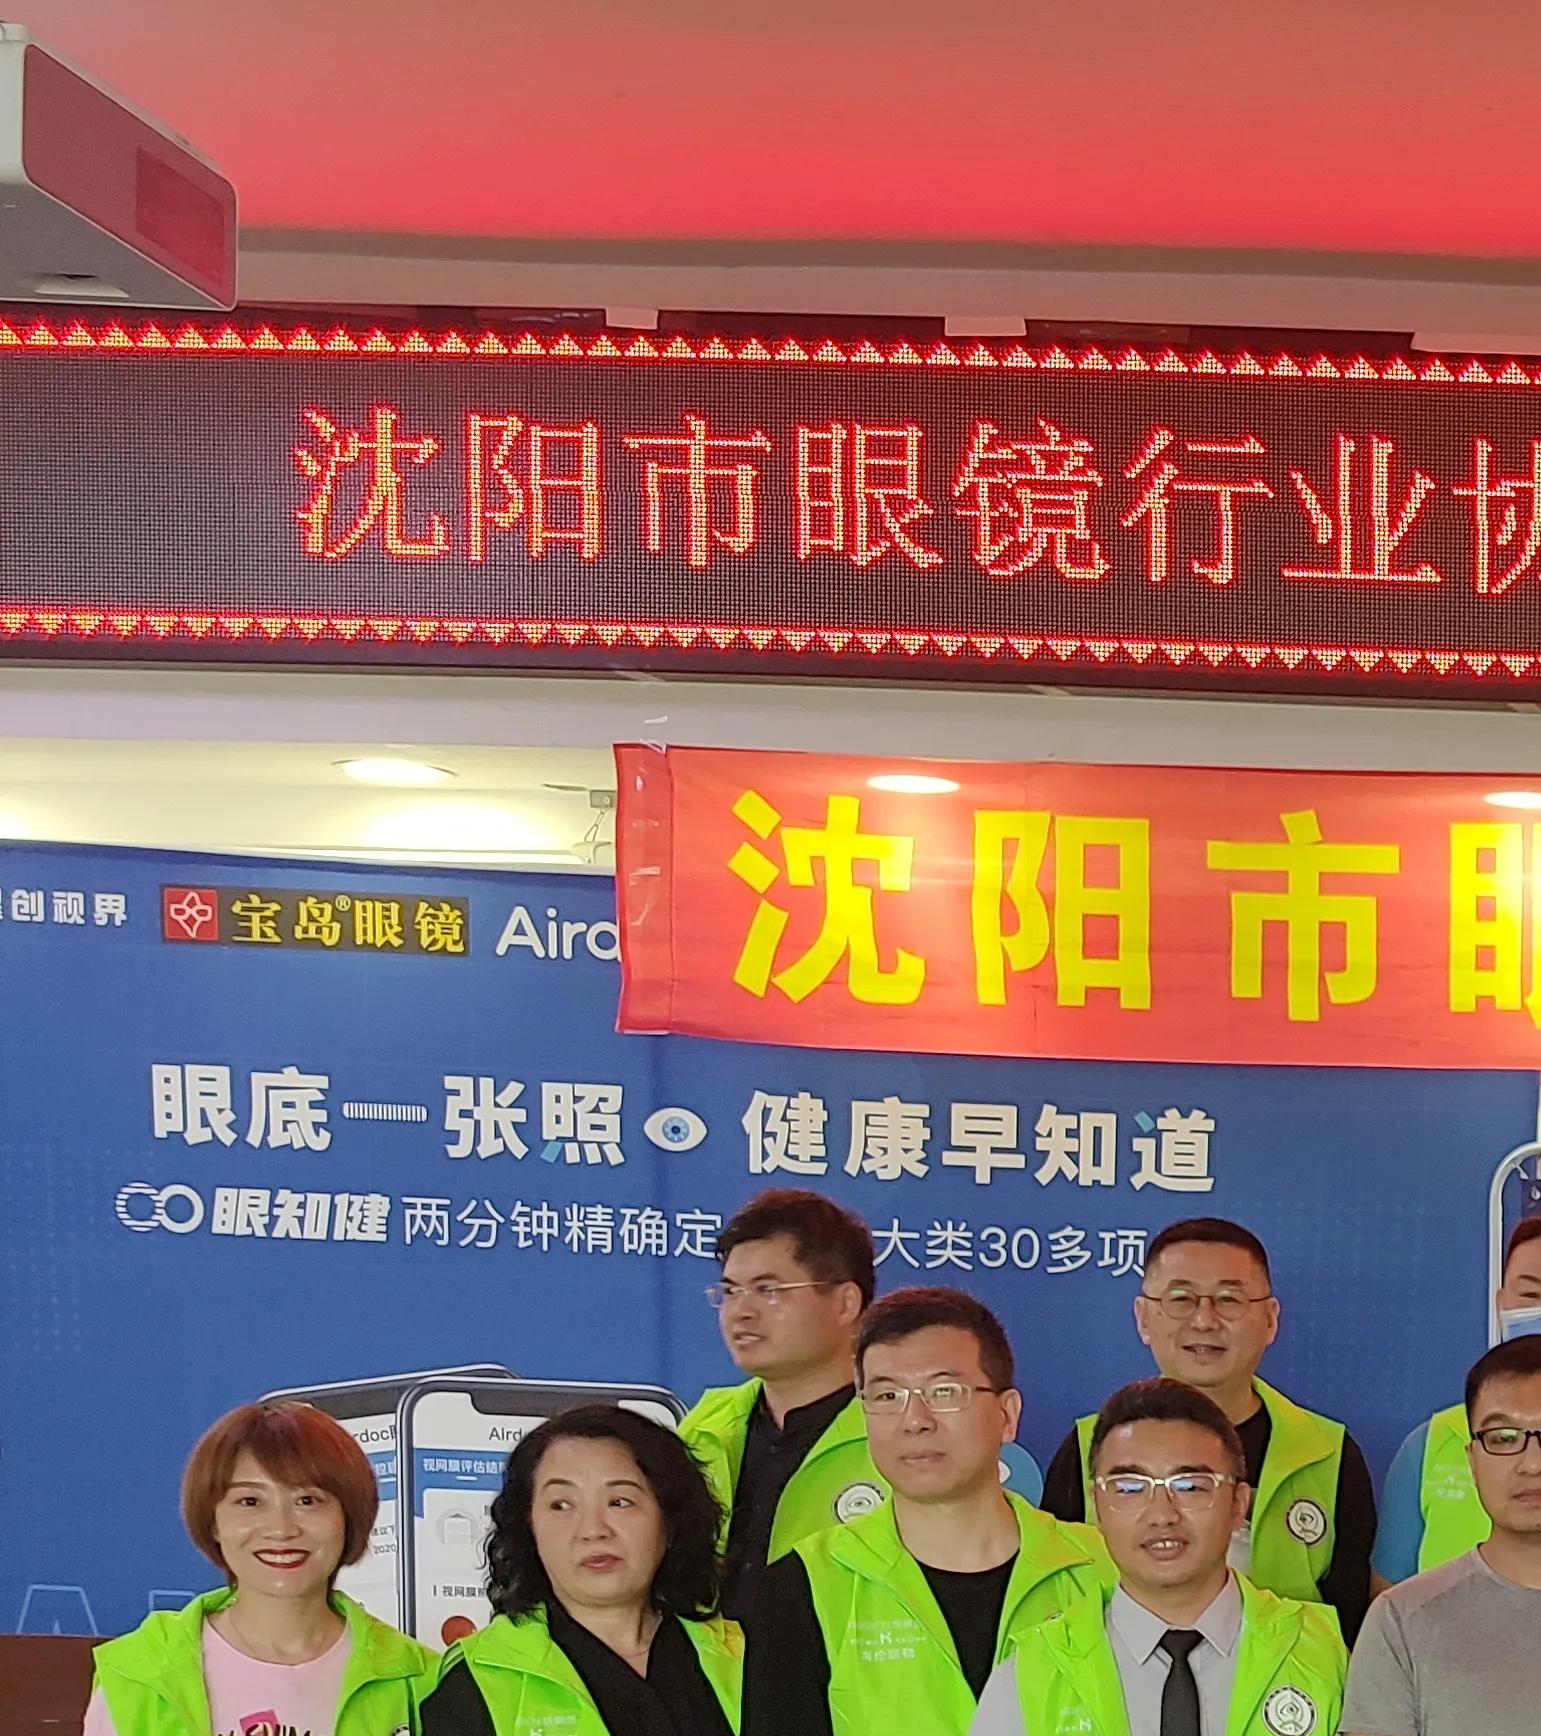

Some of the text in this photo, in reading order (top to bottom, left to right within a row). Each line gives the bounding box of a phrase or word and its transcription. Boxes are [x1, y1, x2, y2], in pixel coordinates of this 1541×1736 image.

[0, 889, 127, 926] 创视界
[151, 1064, 1216, 1192] 眼底一张照 健康早知道
[212, 1187, 391, 1243] 眼知健
